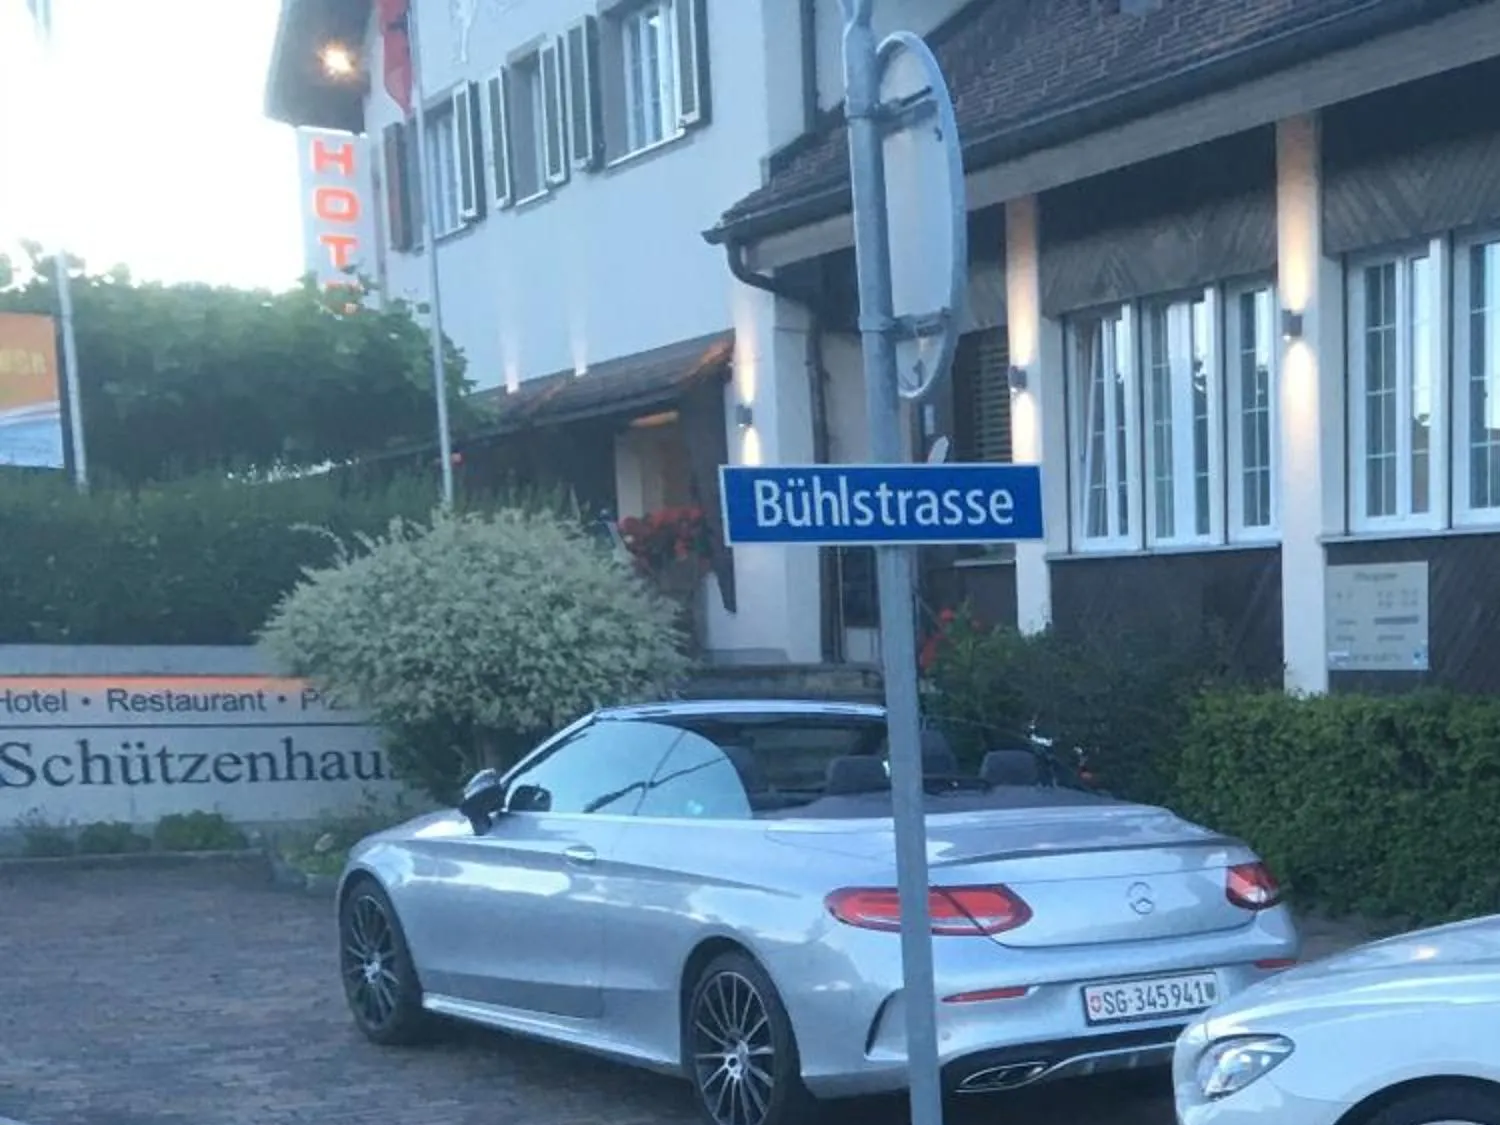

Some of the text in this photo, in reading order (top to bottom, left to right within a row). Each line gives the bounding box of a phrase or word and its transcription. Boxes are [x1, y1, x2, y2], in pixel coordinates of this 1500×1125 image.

[753, 475, 1014, 527] Bühlstrasse
[107, 687, 267, 713] Restaurant
[0, 737, 398, 788] Schützenhau
